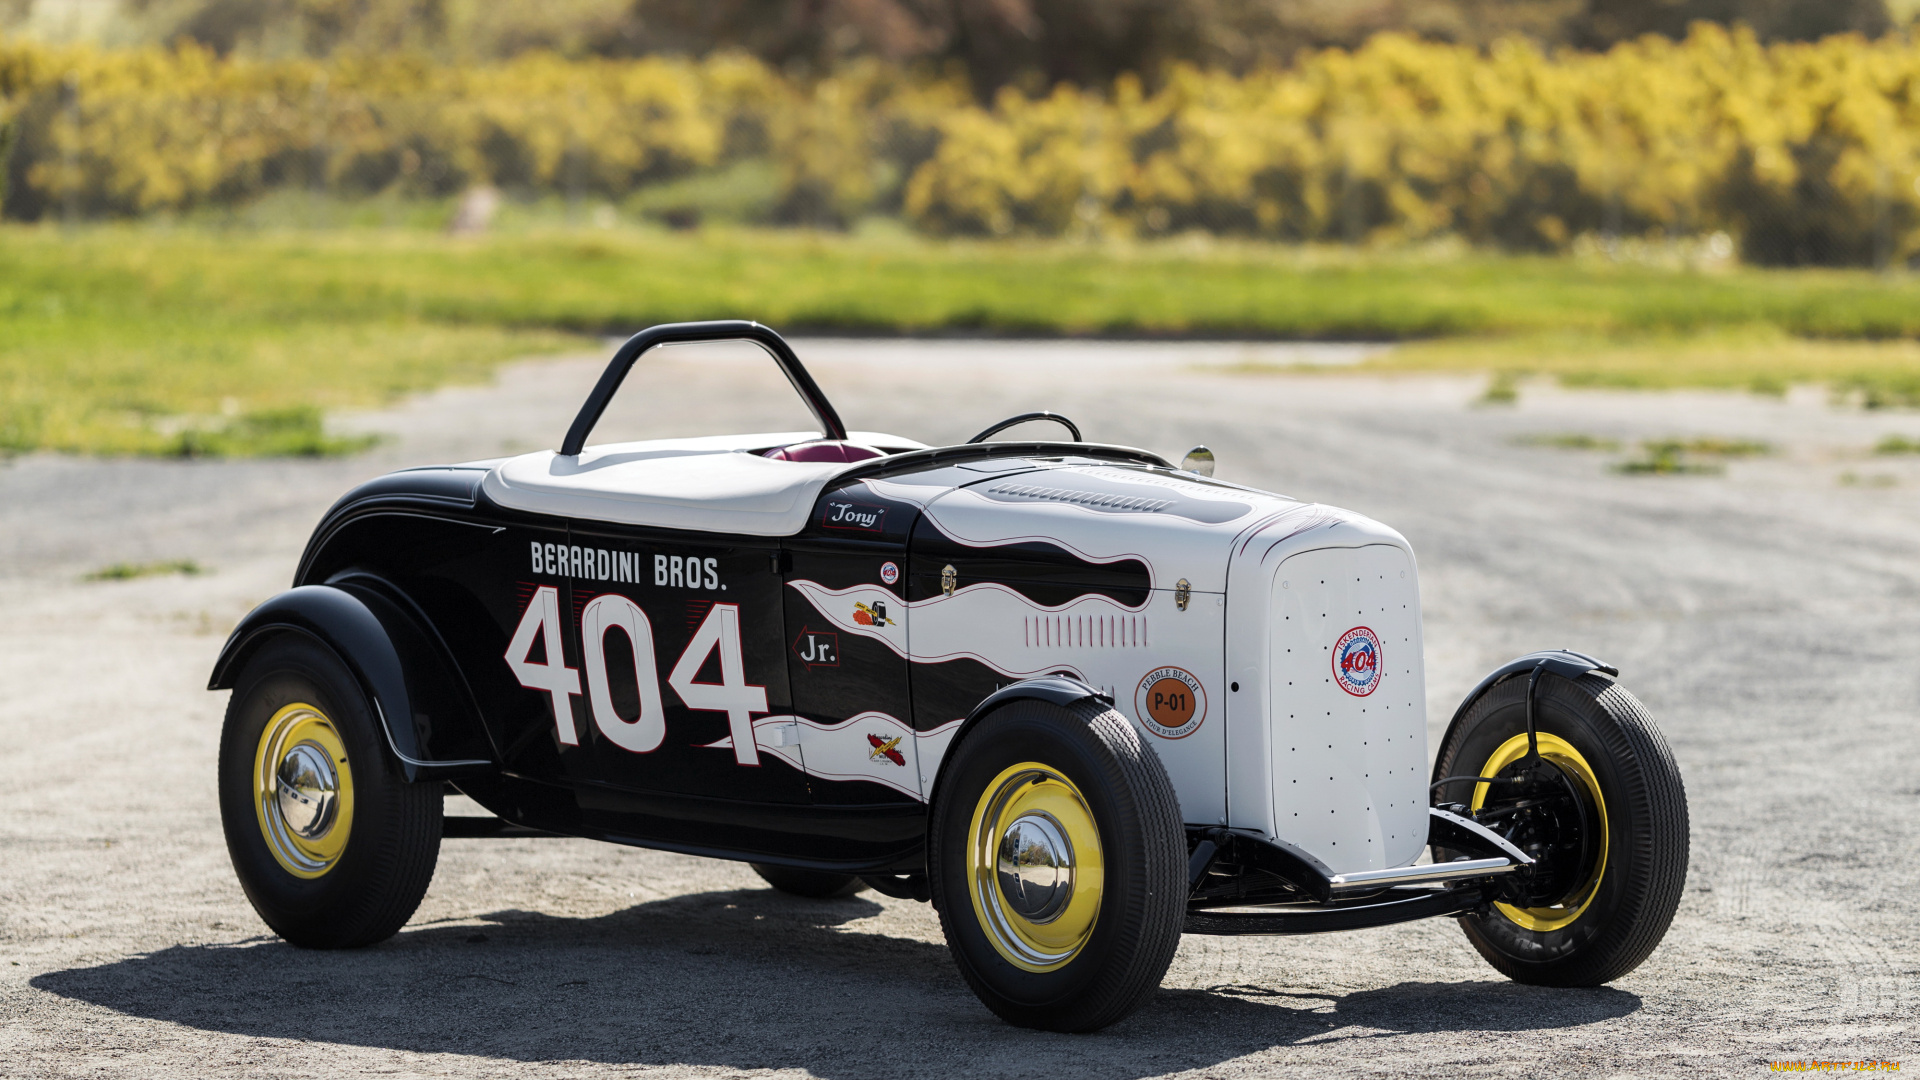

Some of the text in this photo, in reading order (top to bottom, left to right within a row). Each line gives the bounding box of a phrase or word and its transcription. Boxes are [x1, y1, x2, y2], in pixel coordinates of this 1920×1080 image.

[530, 541, 727, 591] BERARDINI BROS.
[800, 635, 836, 662] Jr.
[1341, 651, 1375, 672] 404
[504, 585, 770, 767] 404
[1142, 669, 1199, 692] PEBBLE BEACH
[1339, 676, 1365, 694] RACING
[1368, 673, 1379, 691] CAMS
[1154, 692, 1185, 711] P-01
[1145, 718, 1198, 736] TOUR D'ELEGANCE
